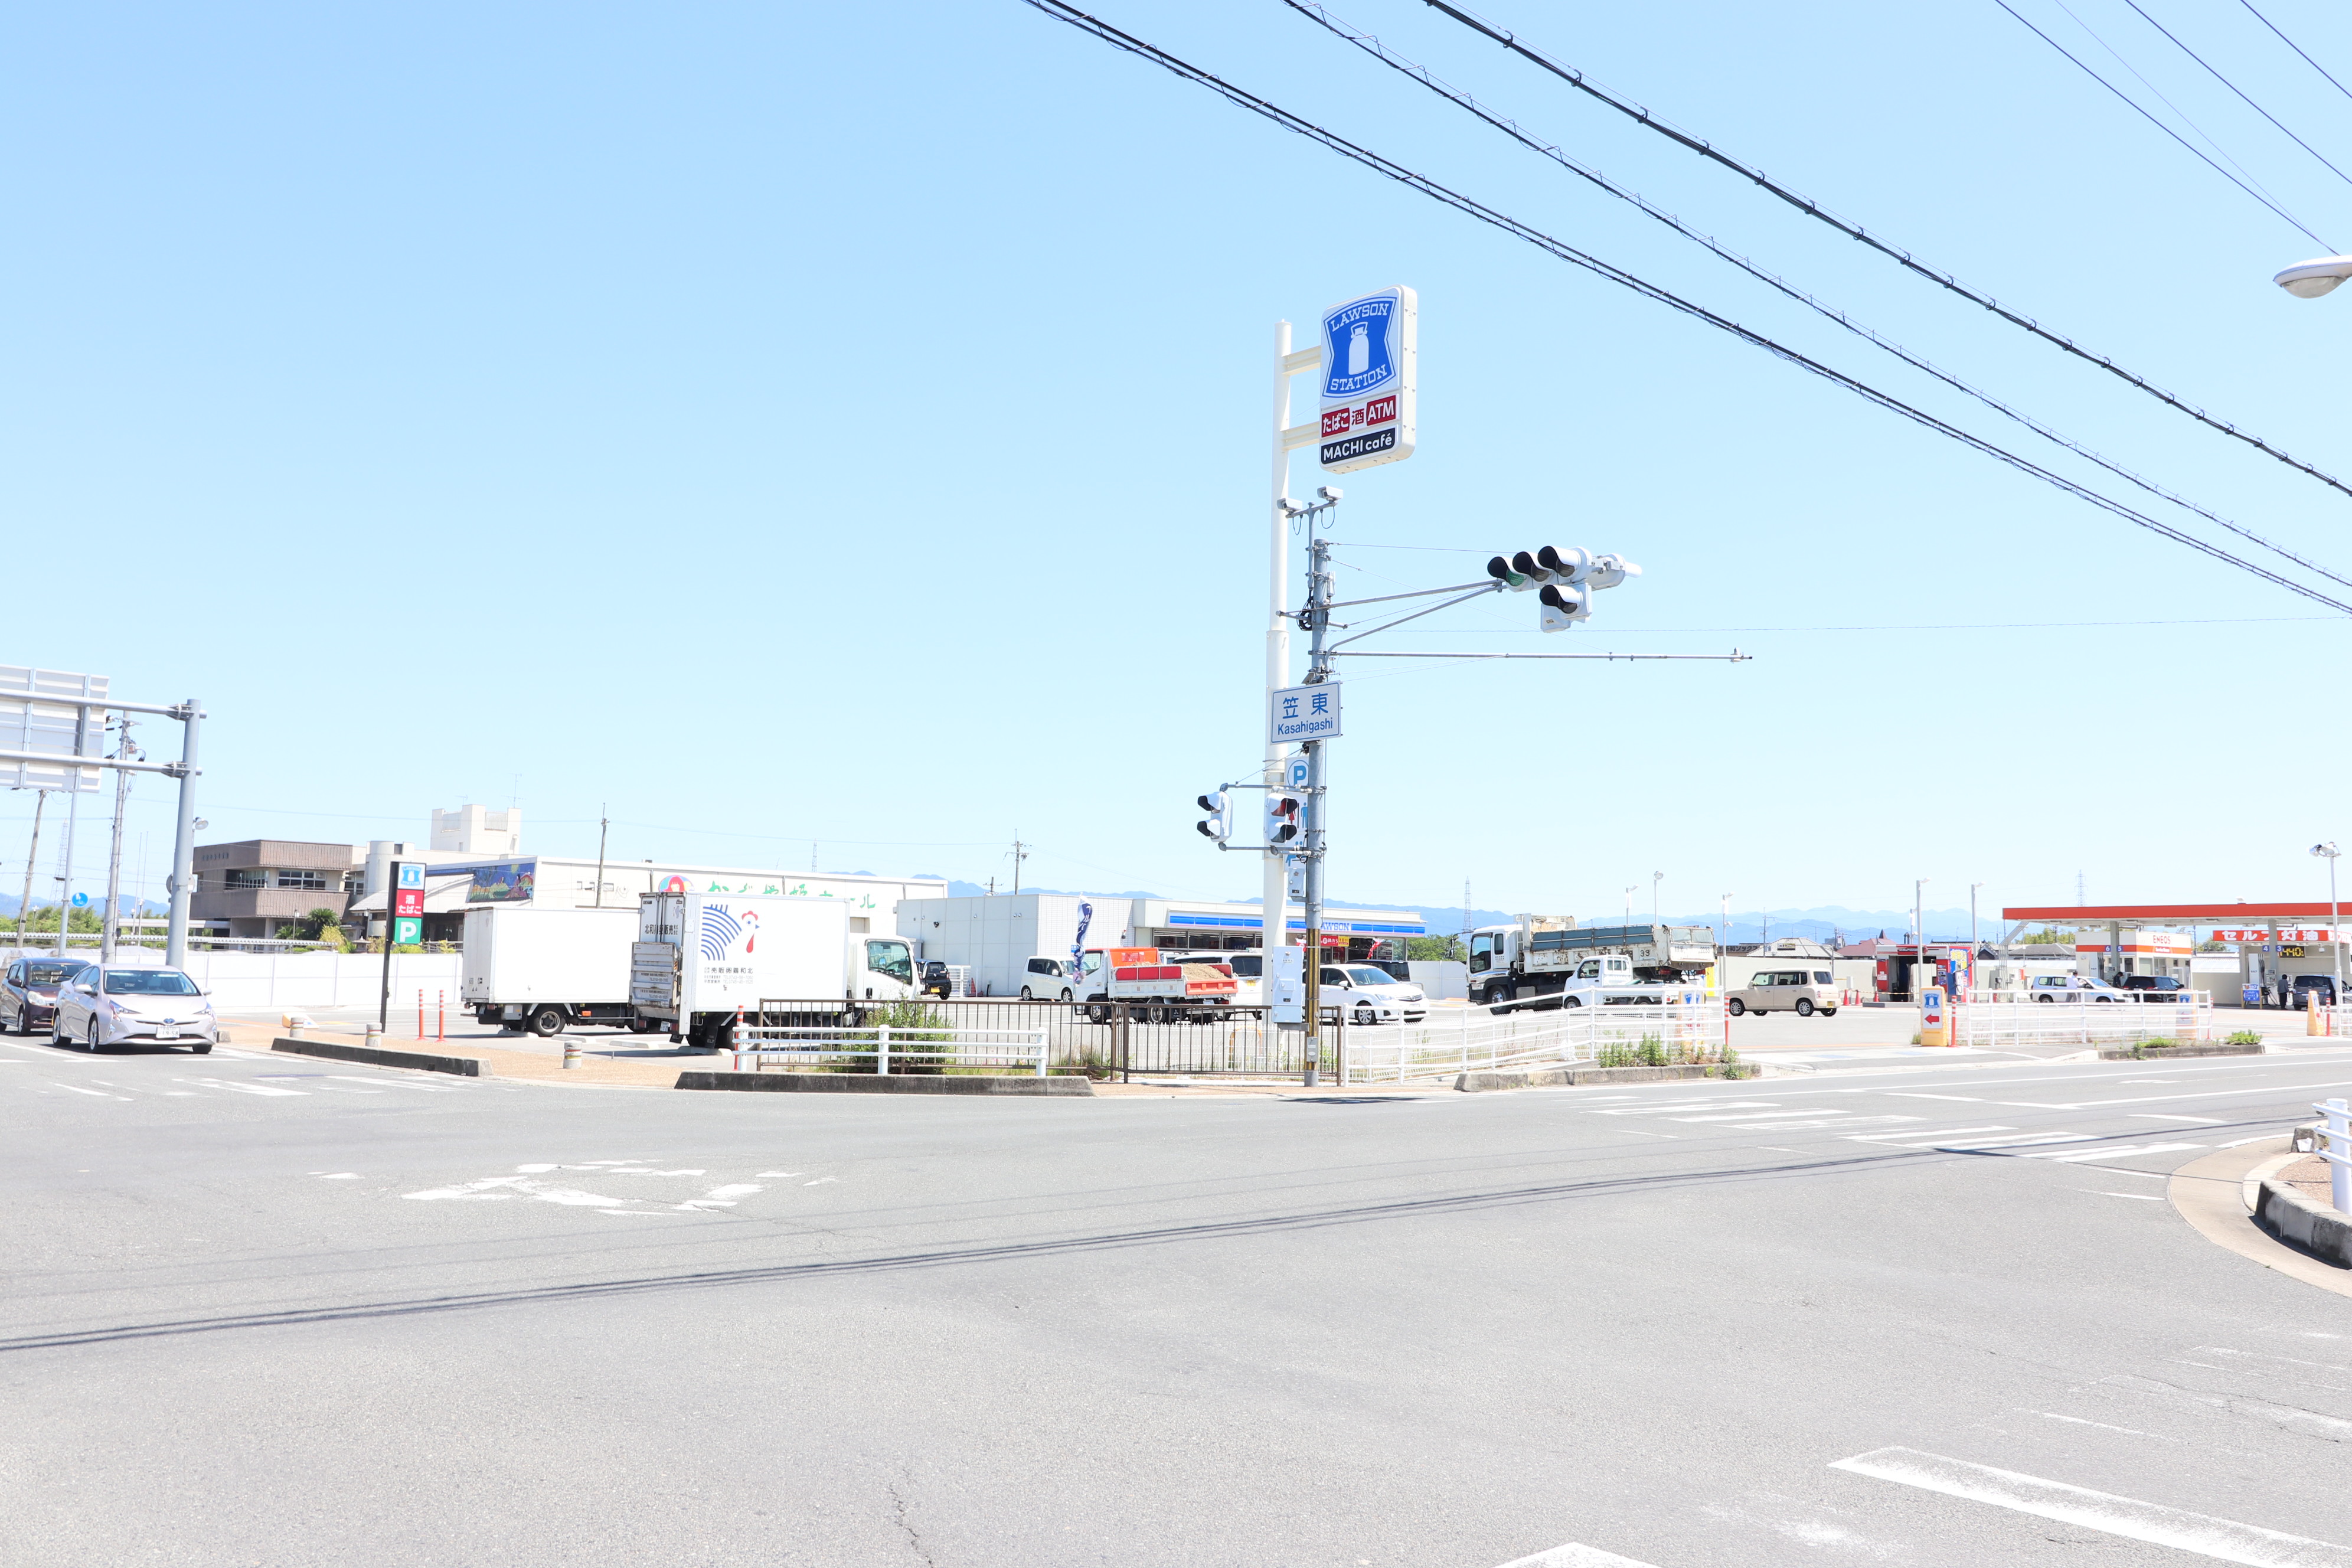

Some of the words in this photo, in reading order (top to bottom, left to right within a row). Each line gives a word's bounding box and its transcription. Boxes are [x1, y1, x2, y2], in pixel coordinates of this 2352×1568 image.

[1331, 303, 1389, 332] LAWSON
[1330, 364, 1387, 391] STATION
[1323, 411, 1349, 433] たばこ
[1352, 410, 1365, 426] 酒
[1367, 400, 1394, 422] ATM
[1324, 440, 1363, 461] MACHI
[1366, 433, 1393, 451] café
[1282, 692, 1328, 720] 笠東
[1278, 717, 1333, 735] Kasahigashi
[1293, 765, 1306, 785] P
[398, 904, 422, 914] たばこ
[406, 894, 415, 904] 酒
[400, 922, 417, 942] P
[1321, 922, 1350, 931] AWSON
[2153, 935, 2171, 944] ENEOS
